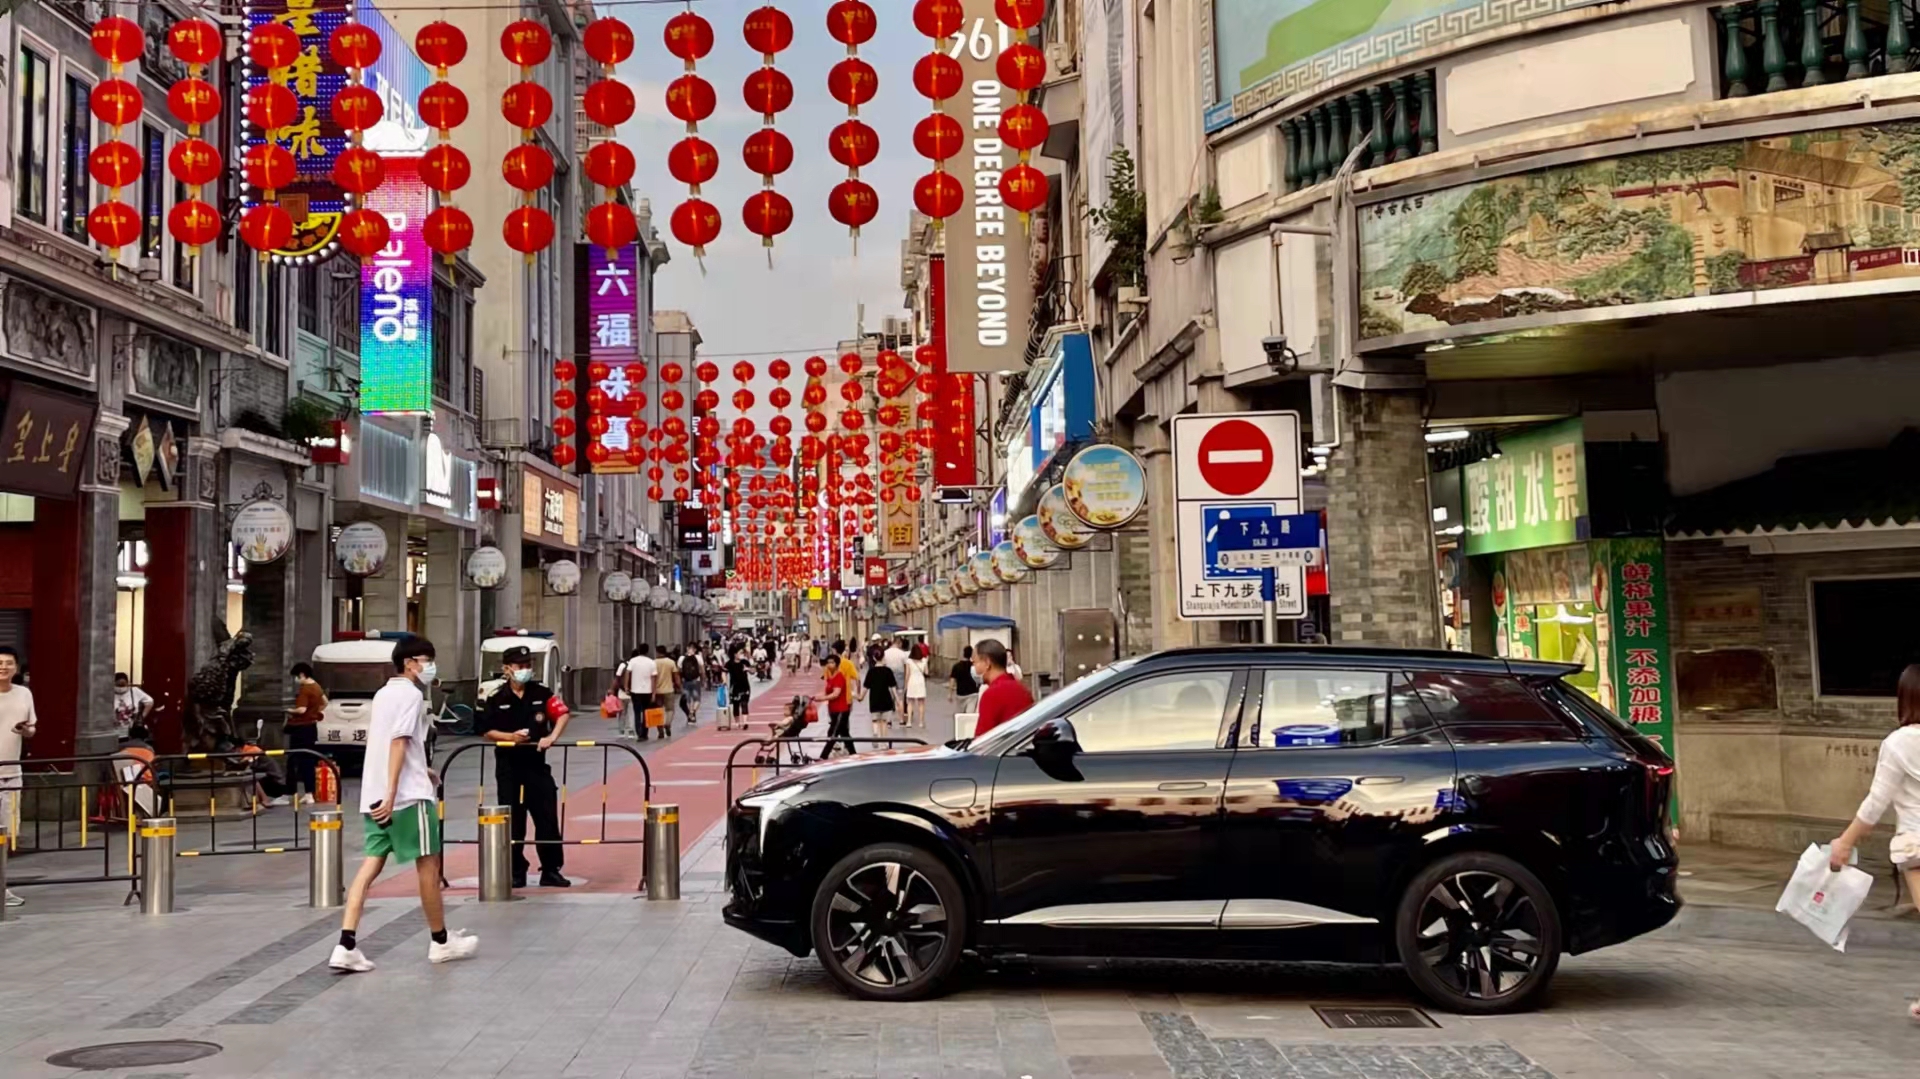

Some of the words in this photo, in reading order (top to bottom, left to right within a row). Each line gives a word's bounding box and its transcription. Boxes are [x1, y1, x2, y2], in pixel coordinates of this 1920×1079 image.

[972, 80, 1001, 130] ONE
[973, 138, 1005, 236] DEGREE
[977, 245, 1007, 346] BEYOND
[1467, 443, 1579, 535] 酸甜水果
[1623, 563, 1655, 637] 鲜榨果汁
[1626, 648, 1661, 723] 不添加糖
